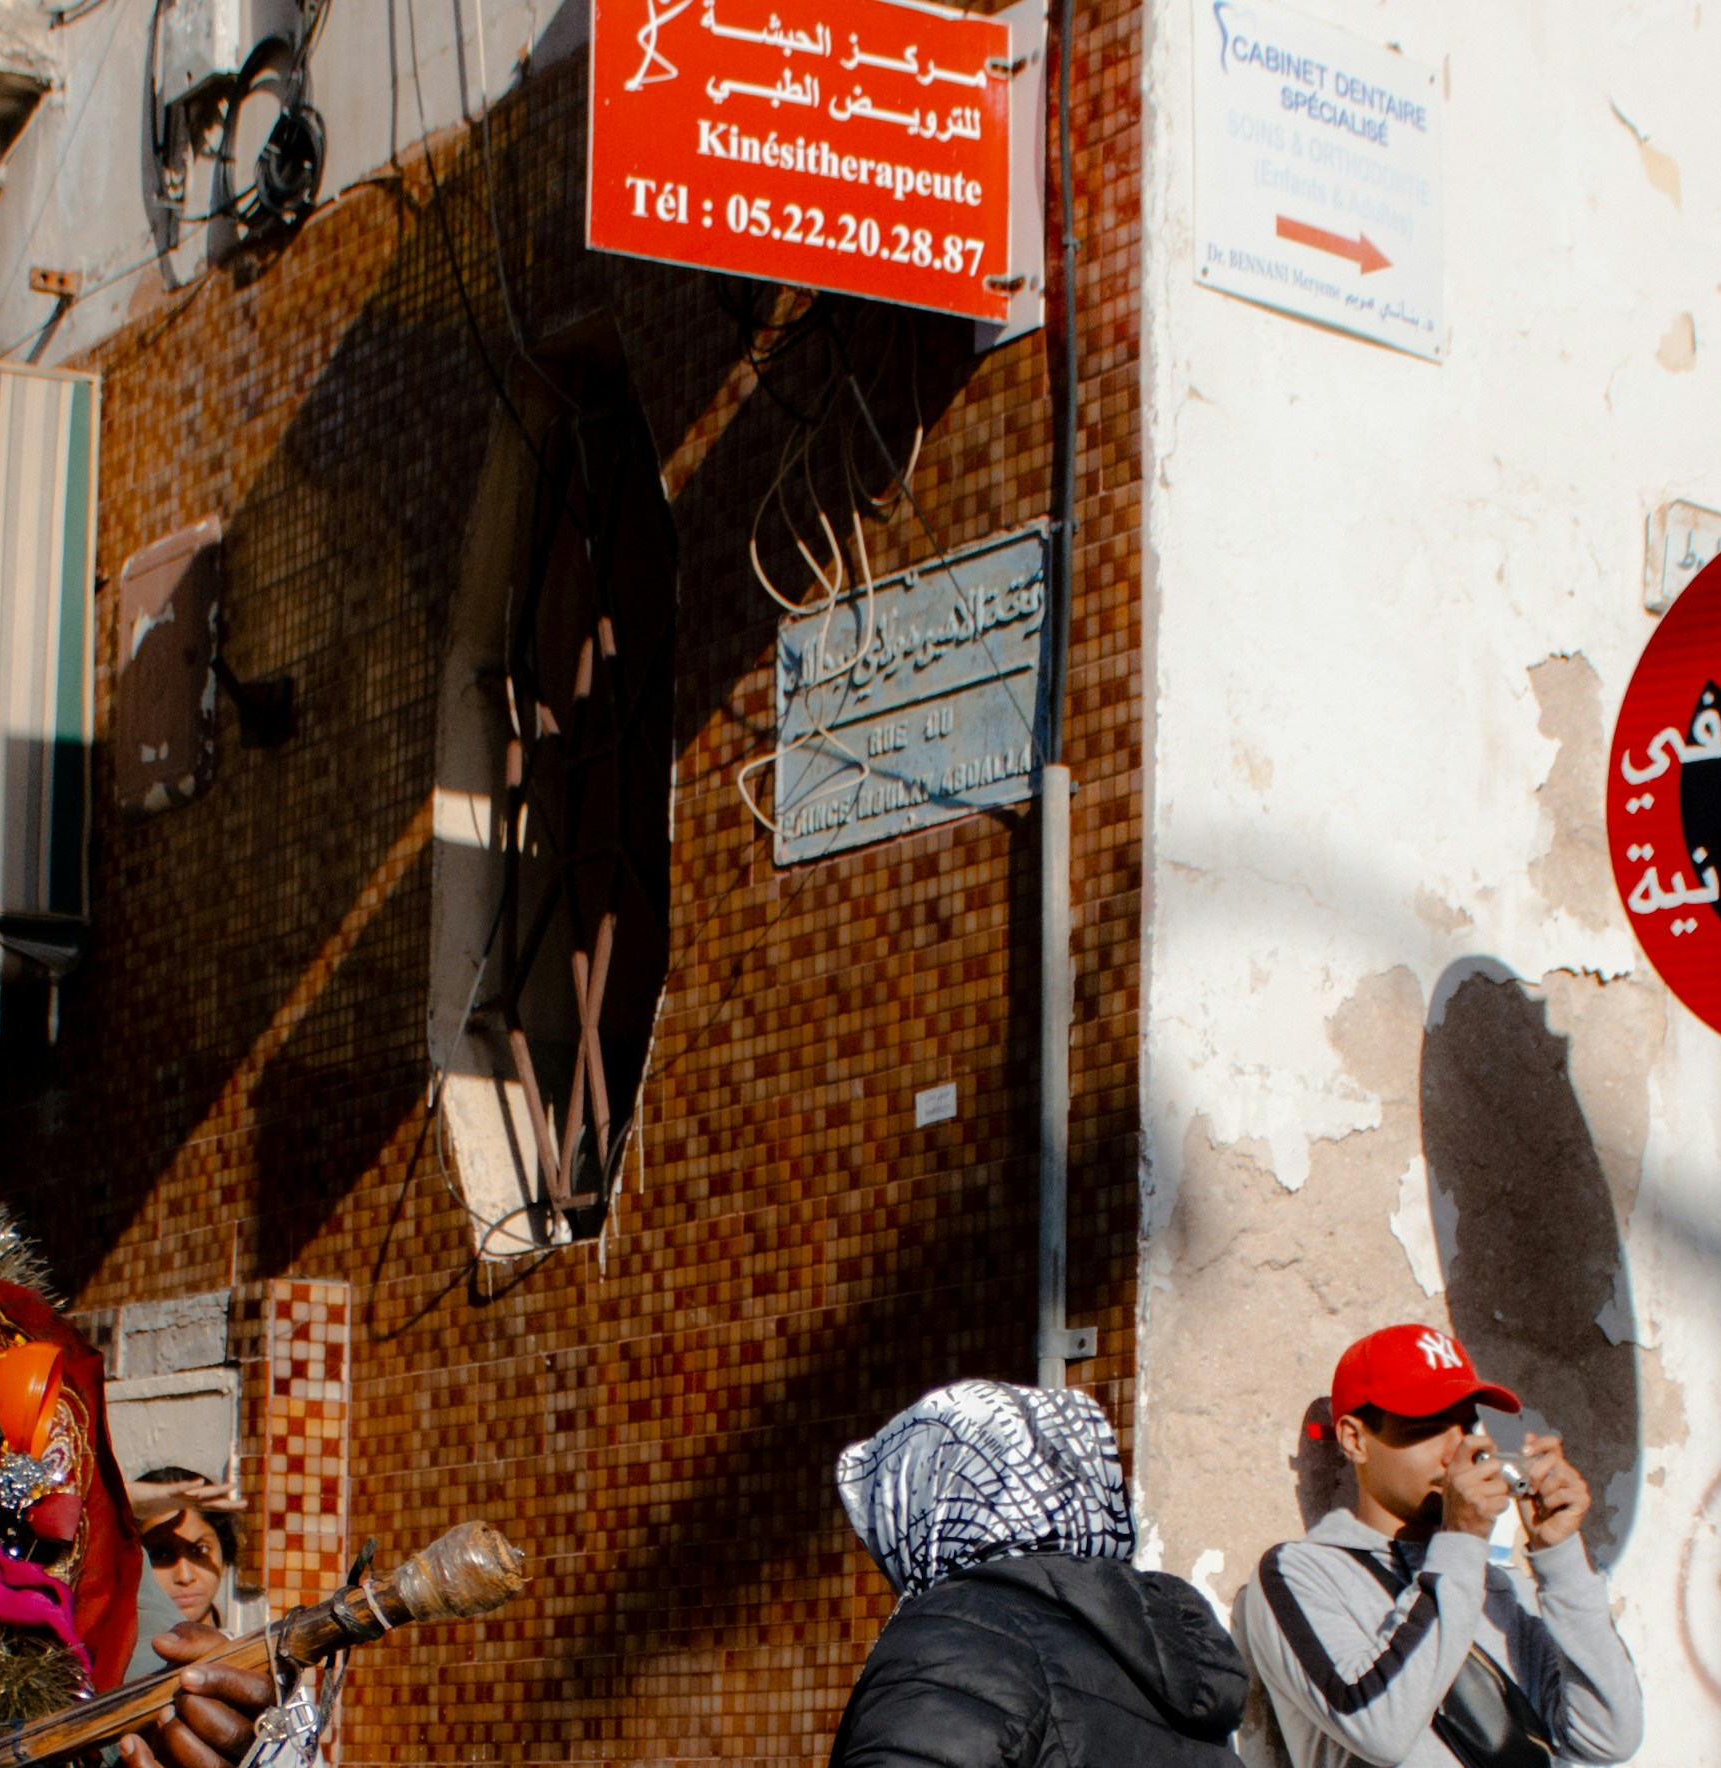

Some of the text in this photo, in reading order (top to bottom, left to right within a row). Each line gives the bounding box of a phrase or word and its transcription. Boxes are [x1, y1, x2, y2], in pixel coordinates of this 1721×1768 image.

[839, 32, 987, 88] مركز
[1232, 34, 1428, 132] CABINET DENTAIRE
[705, 67, 981, 142] للترويض الطبي
[1227, 108, 1285, 152] SOINS
[1281, 84, 1389, 147] SPÉCIALISÉ
[696, 118, 983, 206] Kinésitherapeute
[625, 175, 689, 224] Tél
[726, 193, 985, 278] 05.22.20.28.87
[868, 706, 953, 757] RUE DU
